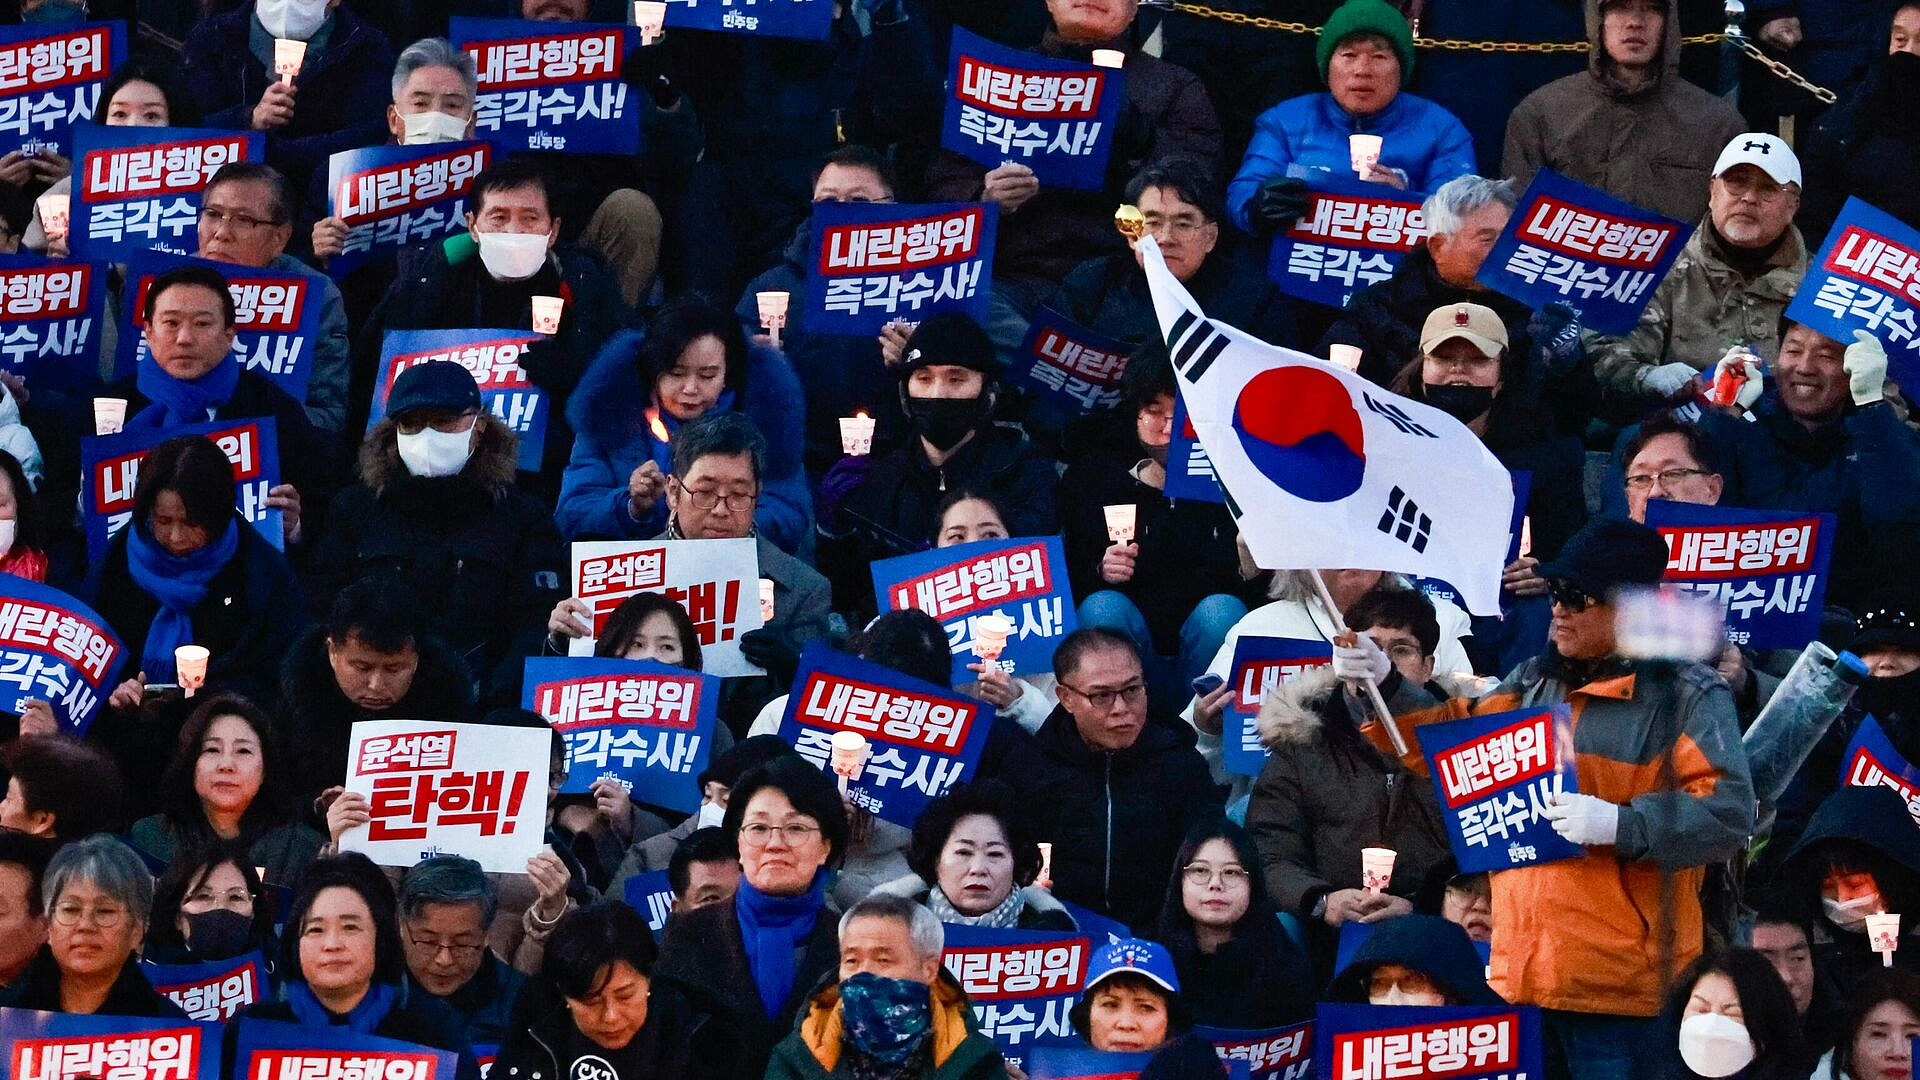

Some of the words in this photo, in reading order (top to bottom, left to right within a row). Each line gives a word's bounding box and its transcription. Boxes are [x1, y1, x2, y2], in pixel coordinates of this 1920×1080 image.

[470, 36, 615, 83] 내란행위
[472, 83, 627, 131] 즉각수사!
[962, 63, 1097, 112] 내란행위
[528, 136, 567, 149] 민주당
[960, 105, 1102, 157] 즉각수사!
[341, 150, 484, 218] 내란행위
[828, 214, 976, 268] 내란행위
[1526, 203, 1670, 262] 내란행위
[0, 270, 82, 314] 행위
[825, 260, 983, 316] 즉각수사!
[1505, 243, 1655, 304] 즉각수사!
[0, 318, 92, 363] 수사!
[582, 552, 661, 593] 윤석열
[1663, 525, 1811, 572] 내란행위
[898, 549, 1045, 617] 내란행위
[0, 651, 97, 726] 각수사!
[541, 679, 695, 724] 내란행위
[805, 680, 969, 747] 내란행위
[361, 735, 451, 772] 윤석열
[1441, 721, 1547, 799] 내란행위
[368, 771, 530, 841] 탄핵!
[169, 969, 253, 1022] 행위
[1341, 1021, 1510, 1080] 내란행위
